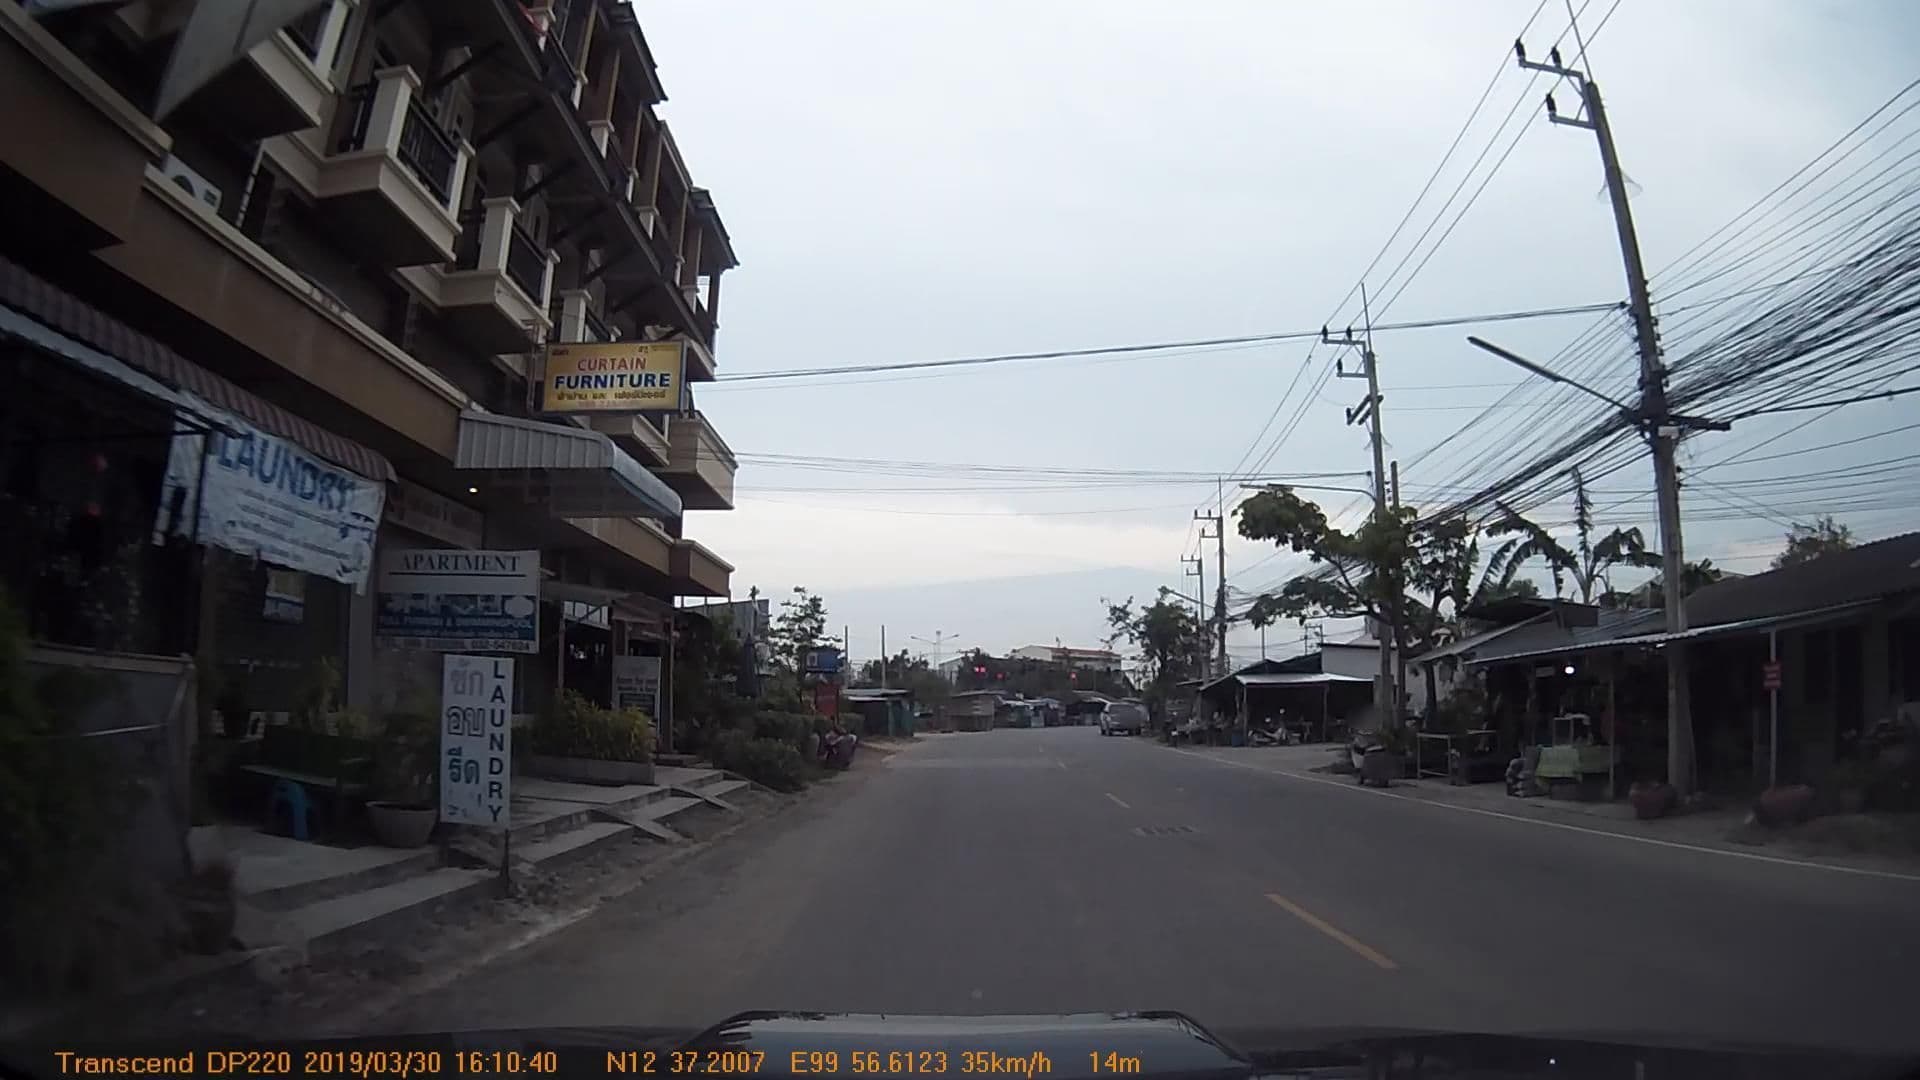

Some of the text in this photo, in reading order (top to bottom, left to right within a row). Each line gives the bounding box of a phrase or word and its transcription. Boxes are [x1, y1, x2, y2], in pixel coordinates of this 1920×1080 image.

[577, 357, 647, 371] CURTAIN
[555, 373, 671, 390] FURNITURE
[218, 430, 357, 511] LAUNDRY
[402, 554, 521, 572] APARTMENT
[446, 705, 486, 738] อบ
[487, 660, 506, 823] LAUNDRY
